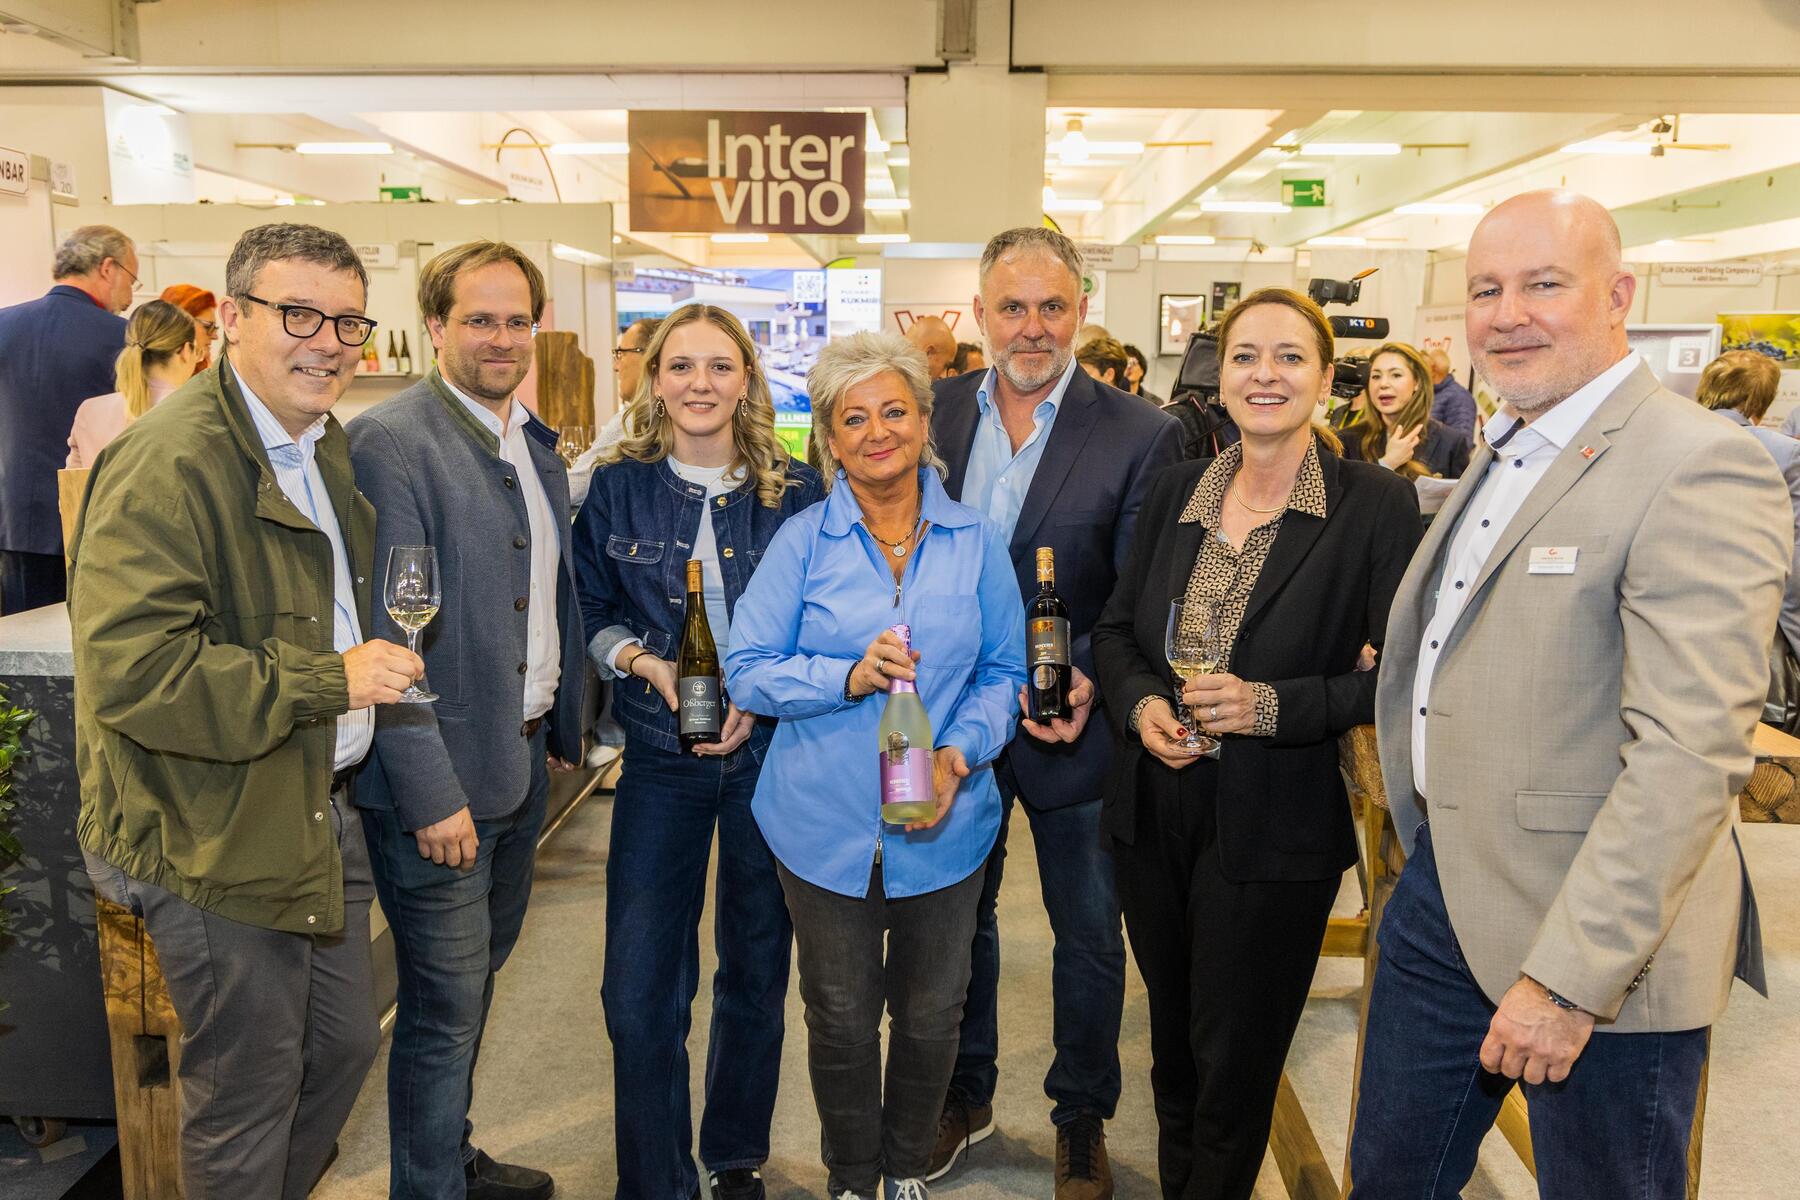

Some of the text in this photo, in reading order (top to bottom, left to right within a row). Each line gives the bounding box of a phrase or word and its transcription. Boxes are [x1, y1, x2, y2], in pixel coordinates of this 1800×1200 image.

[708, 119, 855, 182] Inter
[711, 167, 850, 226] vino
[1684, 350, 1695, 366] 3
